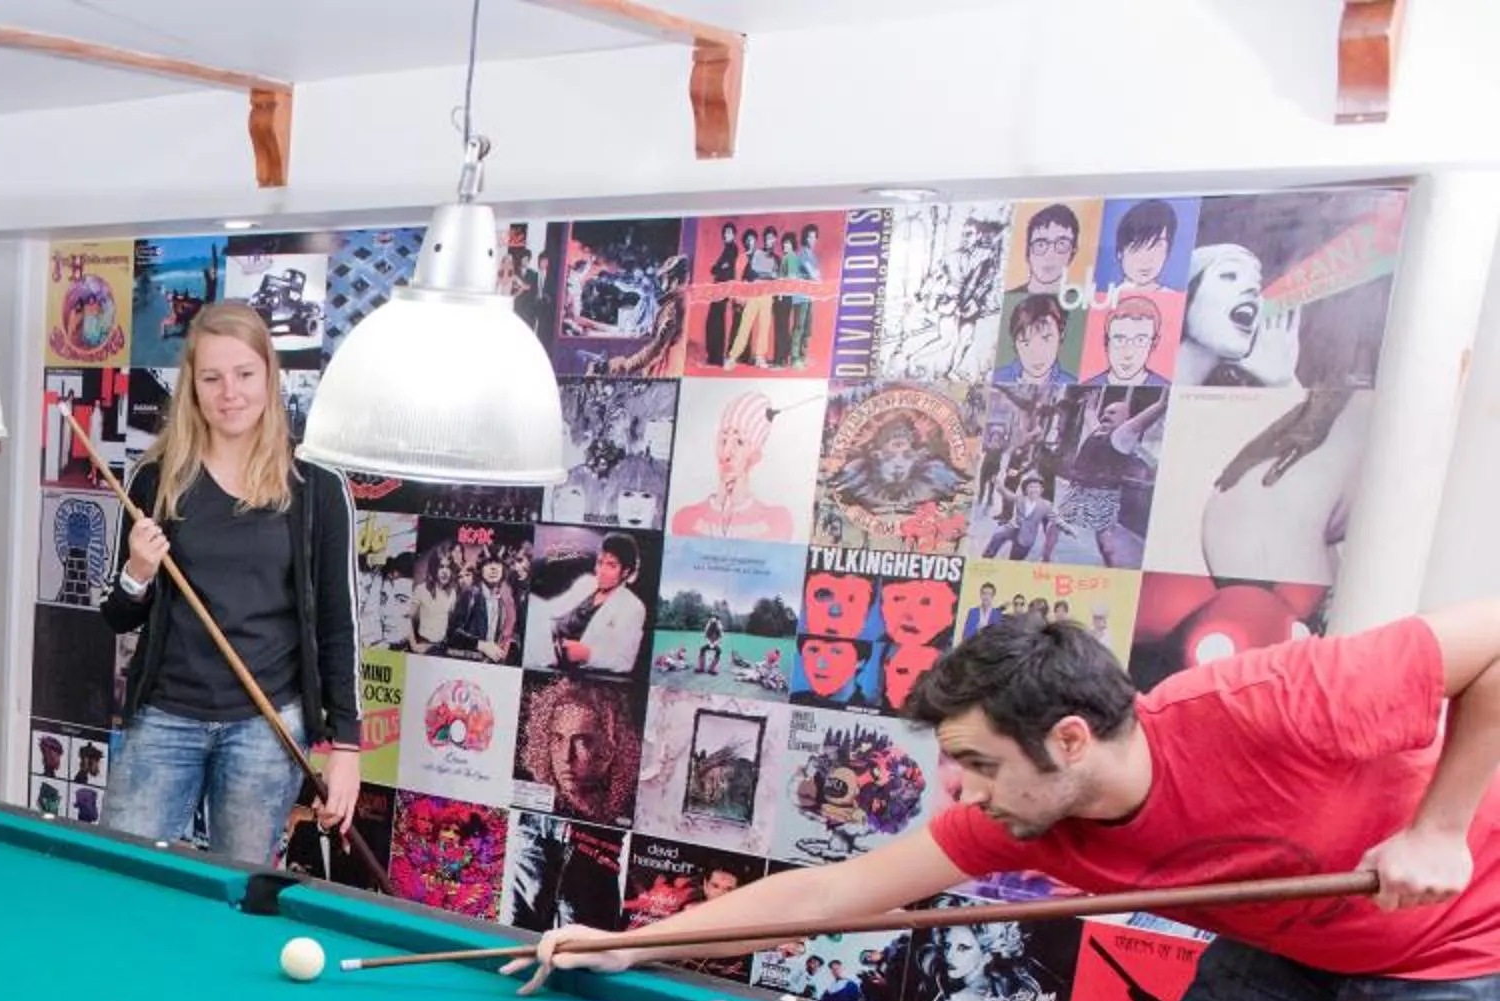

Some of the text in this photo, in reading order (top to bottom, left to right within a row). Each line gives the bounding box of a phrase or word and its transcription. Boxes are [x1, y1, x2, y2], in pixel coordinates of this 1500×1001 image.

[835, 209, 883, 378] DIVIDIDOS
[1059, 265, 1122, 311] blur
[457, 525, 495, 547] AC/DC
[363, 684, 402, 705] OCKS
[647, 844, 680, 859] david
